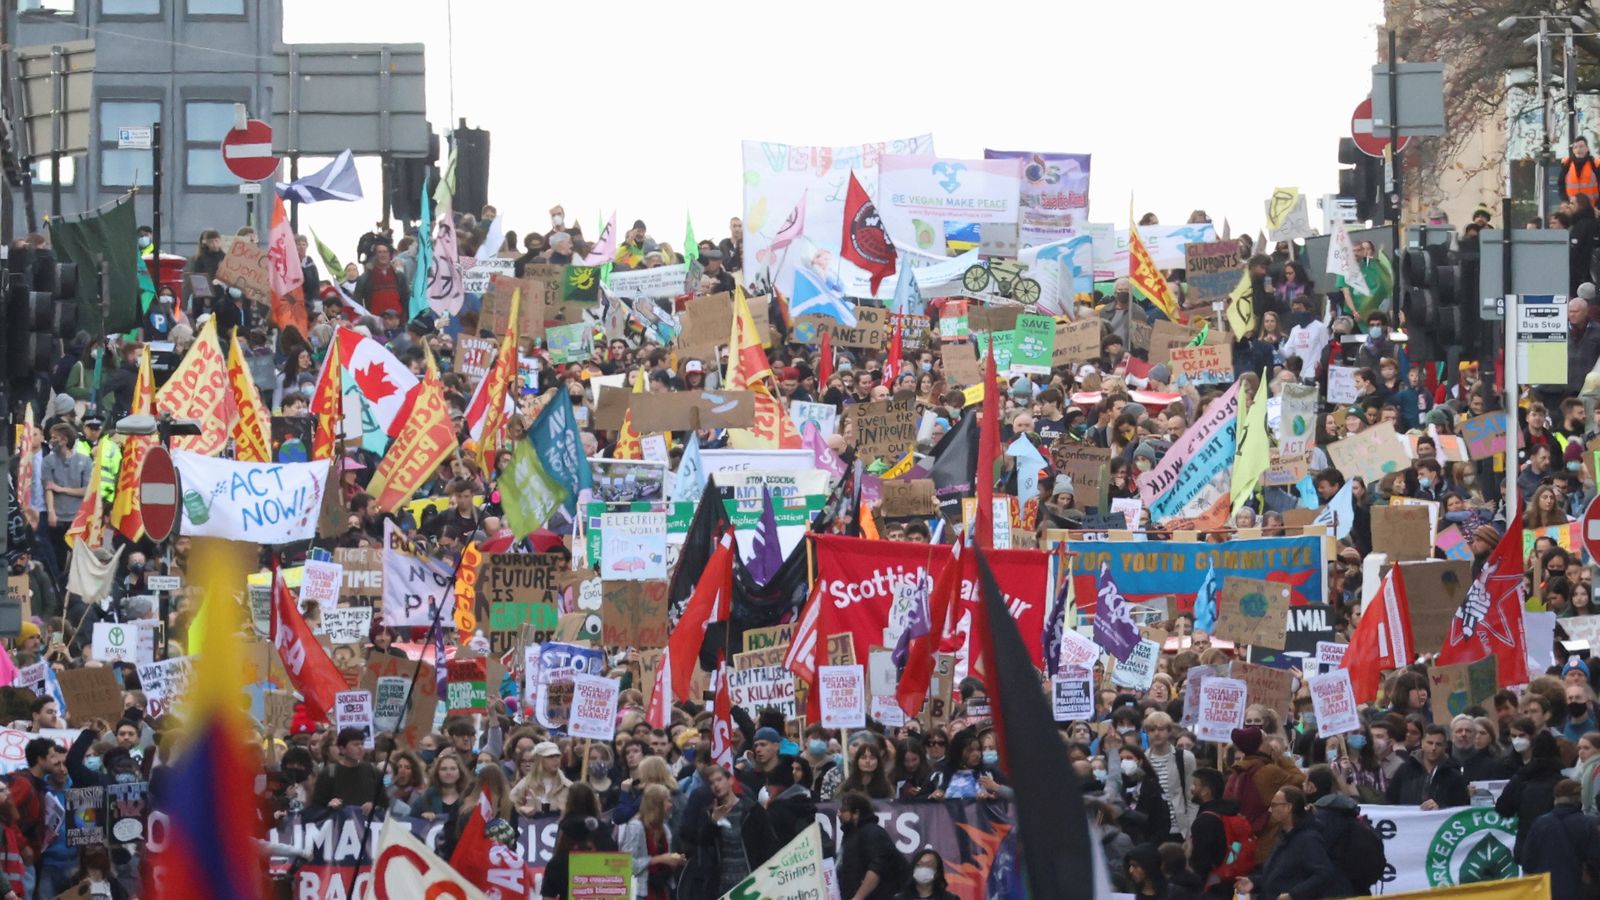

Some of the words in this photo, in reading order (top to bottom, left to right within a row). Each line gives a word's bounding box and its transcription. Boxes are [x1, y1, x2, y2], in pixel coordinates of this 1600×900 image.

[892, 194, 906, 203] BE
[908, 195, 944, 206] VEGAN
[946, 198, 974, 207] MAKE
[977, 199, 1008, 208] PEACE
[1188, 251, 1238, 273] SUPPORTS
[154, 315, 166, 330] P
[858, 310, 878, 324] NO
[1022, 319, 1051, 330] SAVE
[1522, 321, 1539, 329] Bus
[1541, 321, 1561, 330] Stop
[869, 329, 879, 344] B
[1171, 350, 1194, 361] LIKE
[1199, 347, 1217, 357] THE
[1182, 358, 1220, 370] OCEAN
[1185, 371, 1202, 381] WE
[1207, 367, 1231, 380] RISE
[886, 401, 908, 413] Bad
[857, 415, 887, 427] even
[896, 412, 913, 422] the
[1465, 413, 1509, 443] SAV
[1283, 441, 1304, 455] ACT
[229, 467, 286, 501] ACT
[736, 486, 758, 509] NO
[491, 553, 522, 566] OUR
[522, 552, 558, 568] ONLY
[1121, 552, 1185, 573] YOUTH
[1195, 546, 1313, 571] COMMITTEE
[490, 568, 558, 591] FUTURE
[583, 589, 602, 600] COOL
[829, 566, 934, 610] Scottish
[492, 590, 514, 603] IS
[541, 590, 554, 603] A
[324, 611, 347, 620] DON'T
[348, 611, 370, 620] MESS
[490, 602, 558, 630] GREEN
[325, 621, 343, 629] WITH
[347, 620, 362, 628] MY
[326, 628, 361, 639] FUTURE
[748, 632, 777, 651] HOW
[780, 627, 792, 643] M
[490, 630, 556, 653] FURE
[1135, 644, 1151, 653] TEM
[104, 647, 127, 655] EARTH
[1320, 644, 1347, 654] SOCIAL
[1321, 653, 1343, 662] CHAN
[729, 668, 794, 688] CAPITALISM
[448, 682, 473, 691] FUND
[747, 683, 794, 703] KILLING
[337, 693, 369, 704] SOCIALIST
[447, 690, 487, 700] CLIMATE
[376, 703, 401, 711] CLIMAT
[448, 699, 473, 709] JOBS
[777, 862, 817, 886] Stirling
